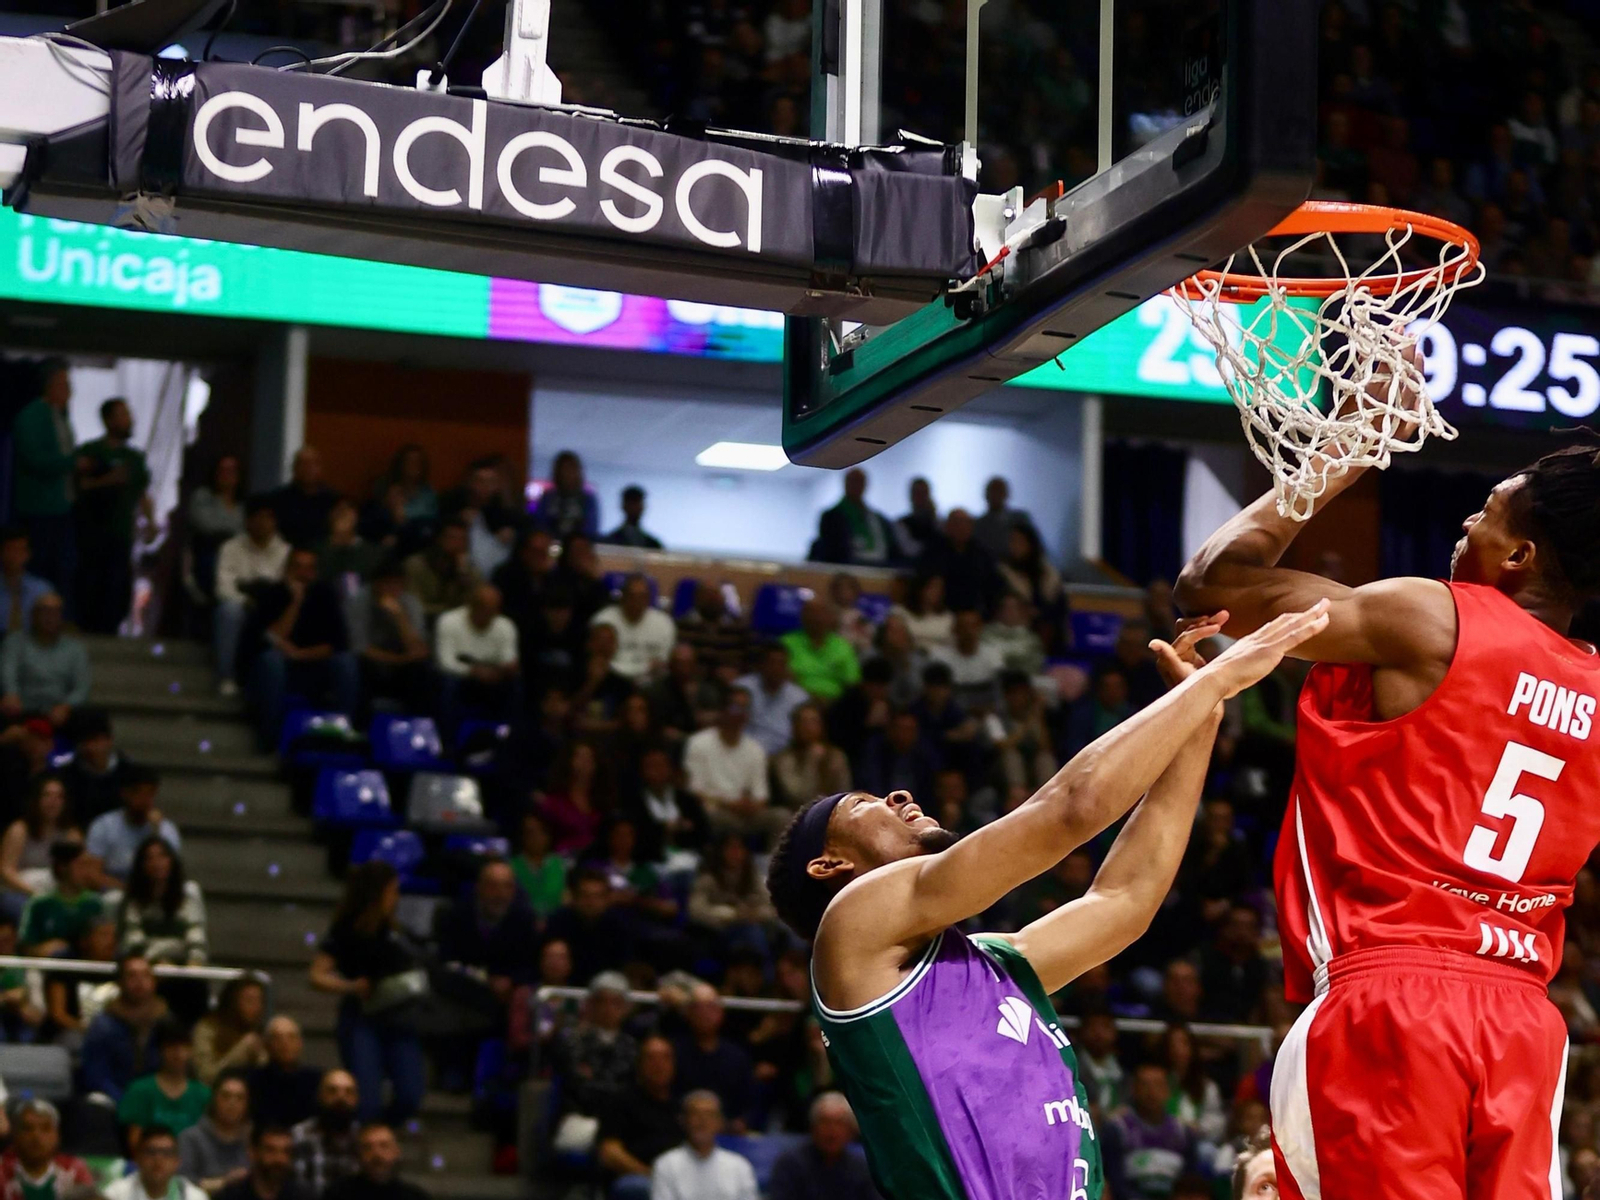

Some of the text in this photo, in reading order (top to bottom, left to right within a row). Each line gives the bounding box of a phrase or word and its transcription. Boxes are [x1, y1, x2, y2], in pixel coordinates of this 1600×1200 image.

[193, 90, 763, 254] endesa
[18, 233, 222, 307] Unicaja
[1506, 671, 1597, 741] PONS
[1463, 740, 1567, 884] 5
[1496, 892, 1557, 914] Home
